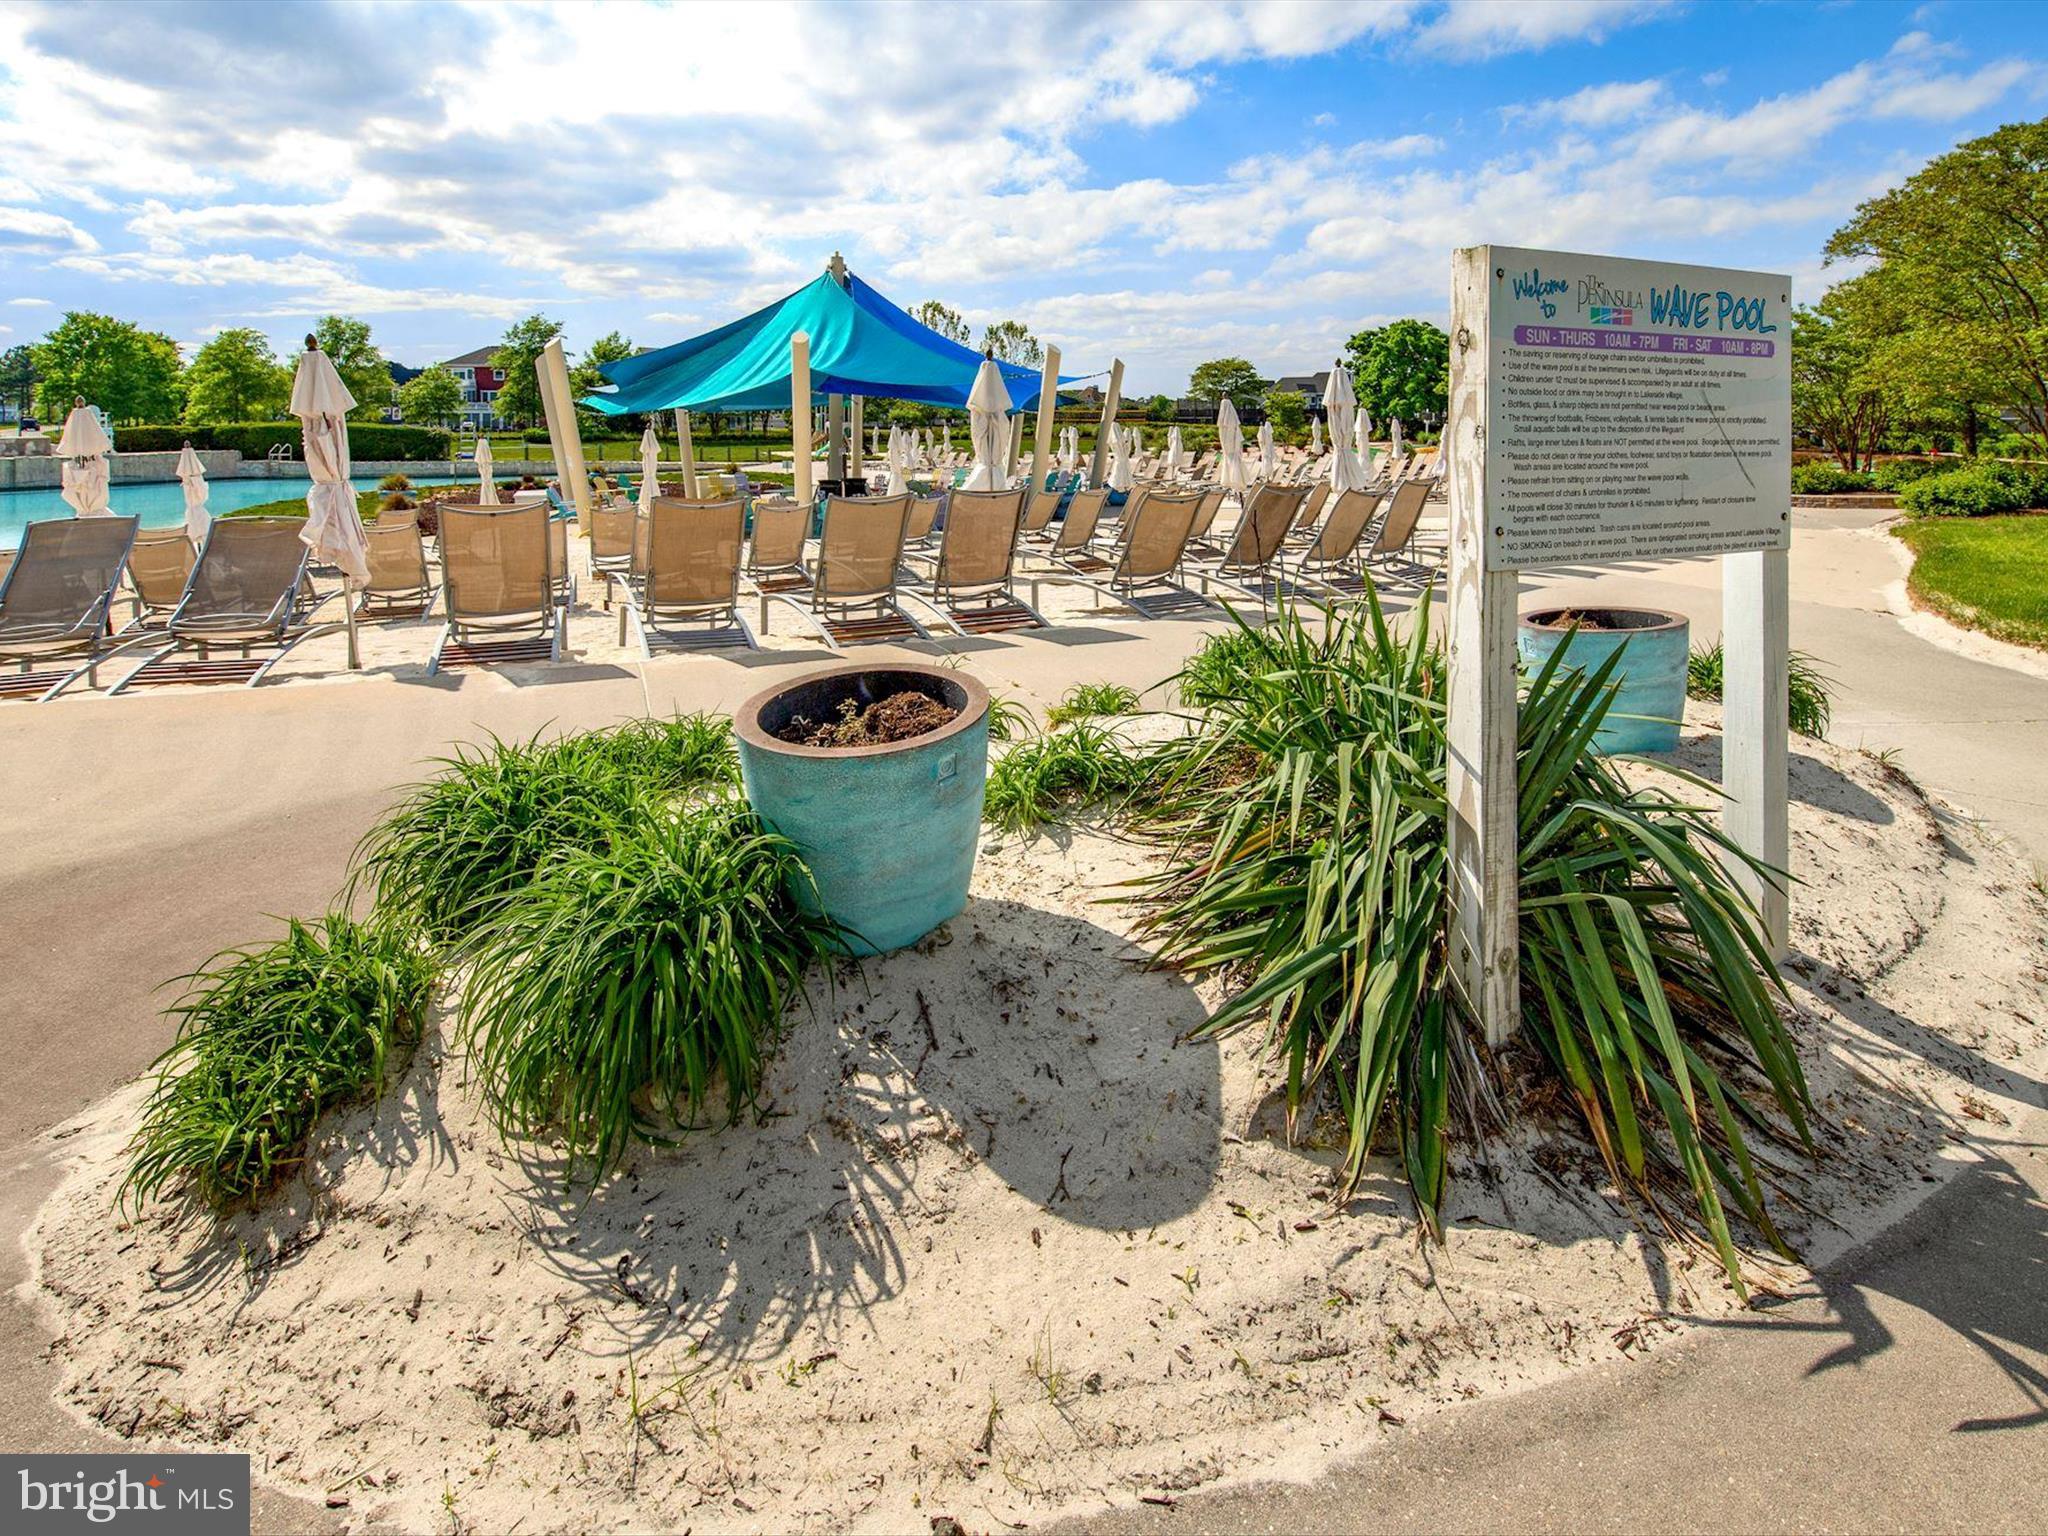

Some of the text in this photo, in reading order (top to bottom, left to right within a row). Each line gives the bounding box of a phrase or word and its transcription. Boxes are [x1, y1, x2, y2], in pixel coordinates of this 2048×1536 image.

[1513, 269, 1568, 301] Welcome
[1586, 274, 1604, 290] The
[1577, 280, 1643, 312] PENINSULA
[1541, 300, 1556, 319] to
[1650, 285, 1776, 333] WAVE POOL
[1526, 329, 1768, 354] SUN THURS 10AM 7PM FRI SAT 10AM 8PM
[1523, 351, 1543, 359] saving
[1553, 353, 1581, 361] reserving
[1589, 353, 1608, 361] lounge
[1560, 364, 1572, 372] pool
[1508, 375, 1534, 383] Children
[1589, 378, 1620, 386] supervised
[1559, 402, 1576, 410] sharp
[1522, 414, 1548, 423] throwing
[1514, 425, 1531, 433] Small
[1533, 426, 1555, 434] aquatic
[1507, 452, 1529, 460] Please
[1593, 453, 1606, 461] your
[1568, 476, 1584, 484] sitting
[1563, 489, 1580, 497] chairs
[1507, 504, 1515, 512] All
[1517, 505, 1534, 513] pools
[1536, 503, 1545, 511] will
[1547, 503, 1563, 511] close
[1574, 502, 1597, 510] minutes
[1598, 501, 1606, 509] for
[1513, 515, 1534, 524] begins
[1536, 514, 1548, 522] with
[1531, 528, 1547, 536] leave
[1558, 526, 1574, 534] trash
[1520, 541, 1552, 550] SMOKING
[1563, 540, 1582, 548] beach
[1507, 556, 1529, 564] Please
[1541, 554, 1571, 562] courteous
[1580, 552, 1598, 560] others
[1600, 551, 1620, 559] around
